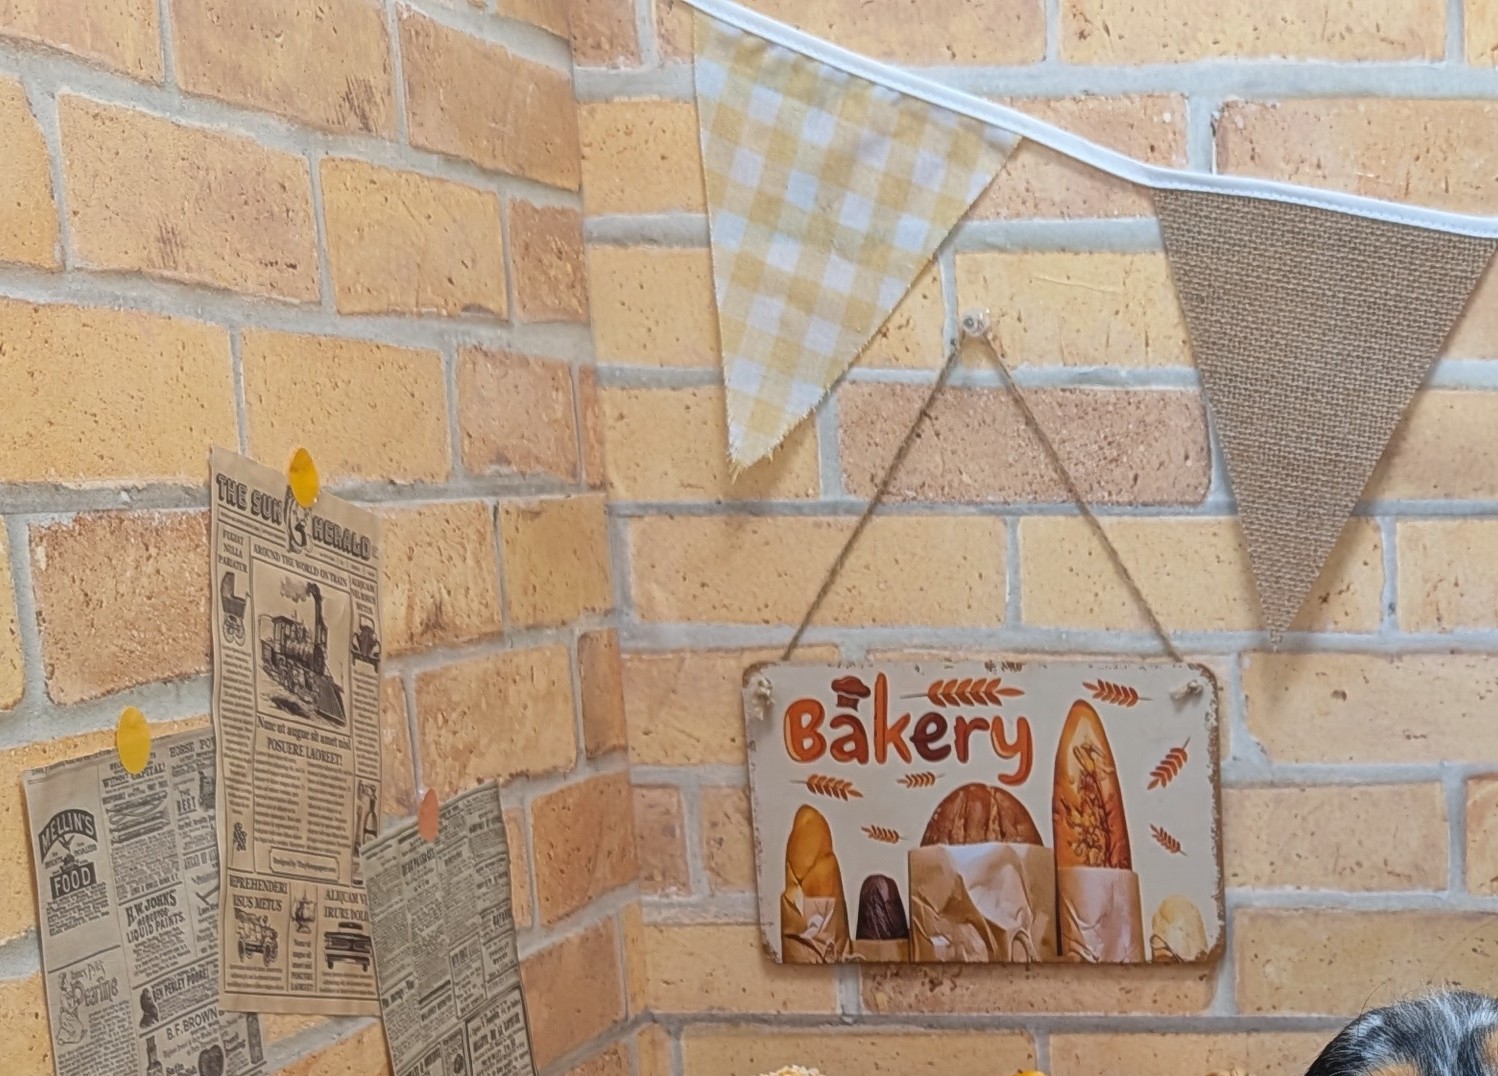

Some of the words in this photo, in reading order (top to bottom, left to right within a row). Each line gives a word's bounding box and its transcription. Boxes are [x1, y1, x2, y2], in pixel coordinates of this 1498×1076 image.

[216, 473, 247, 510] THE
[251, 489, 283, 525] SUN
[312, 515, 371, 561] HERALD
[253, 544, 281, 562] AROUND
[282, 553, 294, 567] THE
[295, 558, 320, 577] WORLD
[320, 569, 330, 580] ON
[267, 737, 305, 757] POSUERE
[783, 672, 1033, 786] Bakery
[40, 812, 95, 857] MELLIN'S
[53, 867, 91, 897] FOOD
[183, 1006, 218, 1032] BROWN
